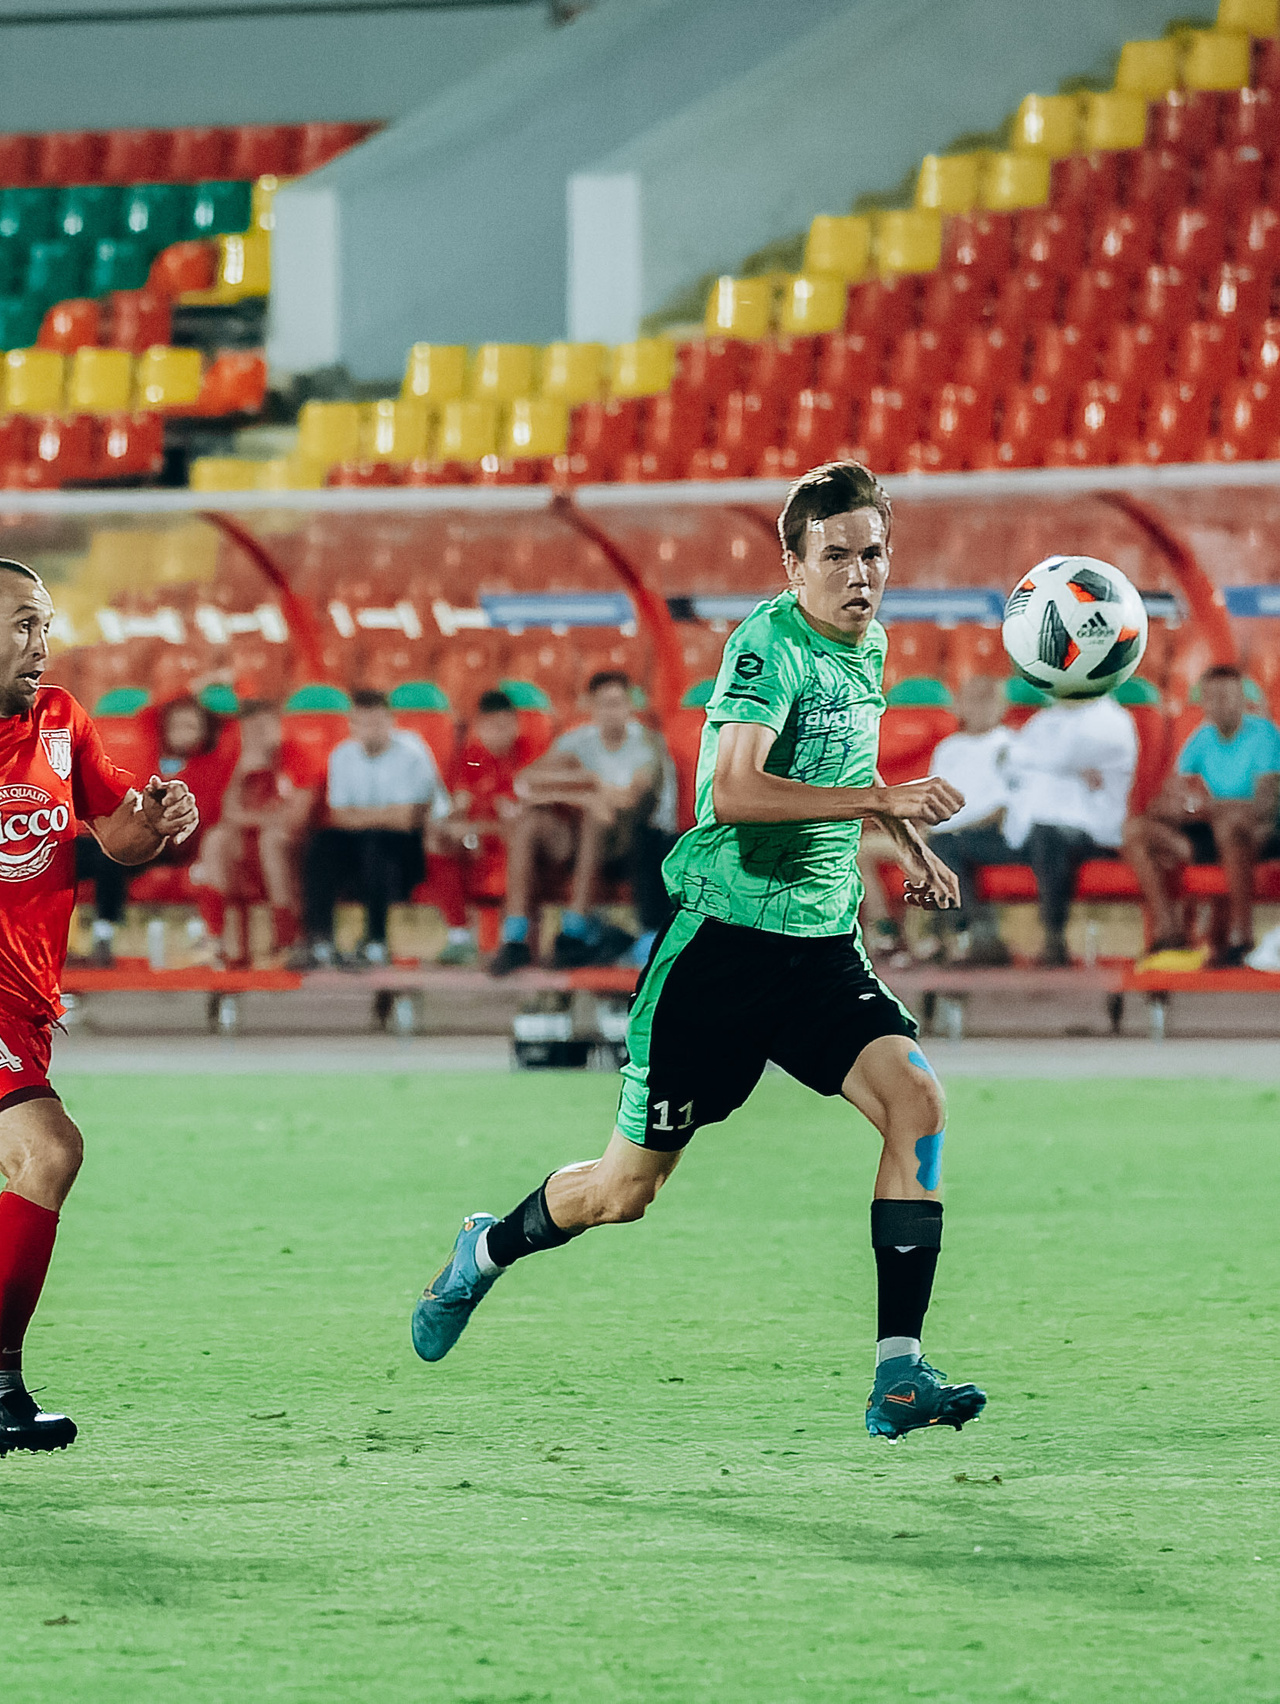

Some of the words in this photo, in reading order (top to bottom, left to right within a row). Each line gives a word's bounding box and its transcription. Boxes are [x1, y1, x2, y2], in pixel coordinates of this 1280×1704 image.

[738, 657, 760, 674] 2
[10, 787, 51, 805] QUALITY
[651, 1099, 696, 1132] 11
